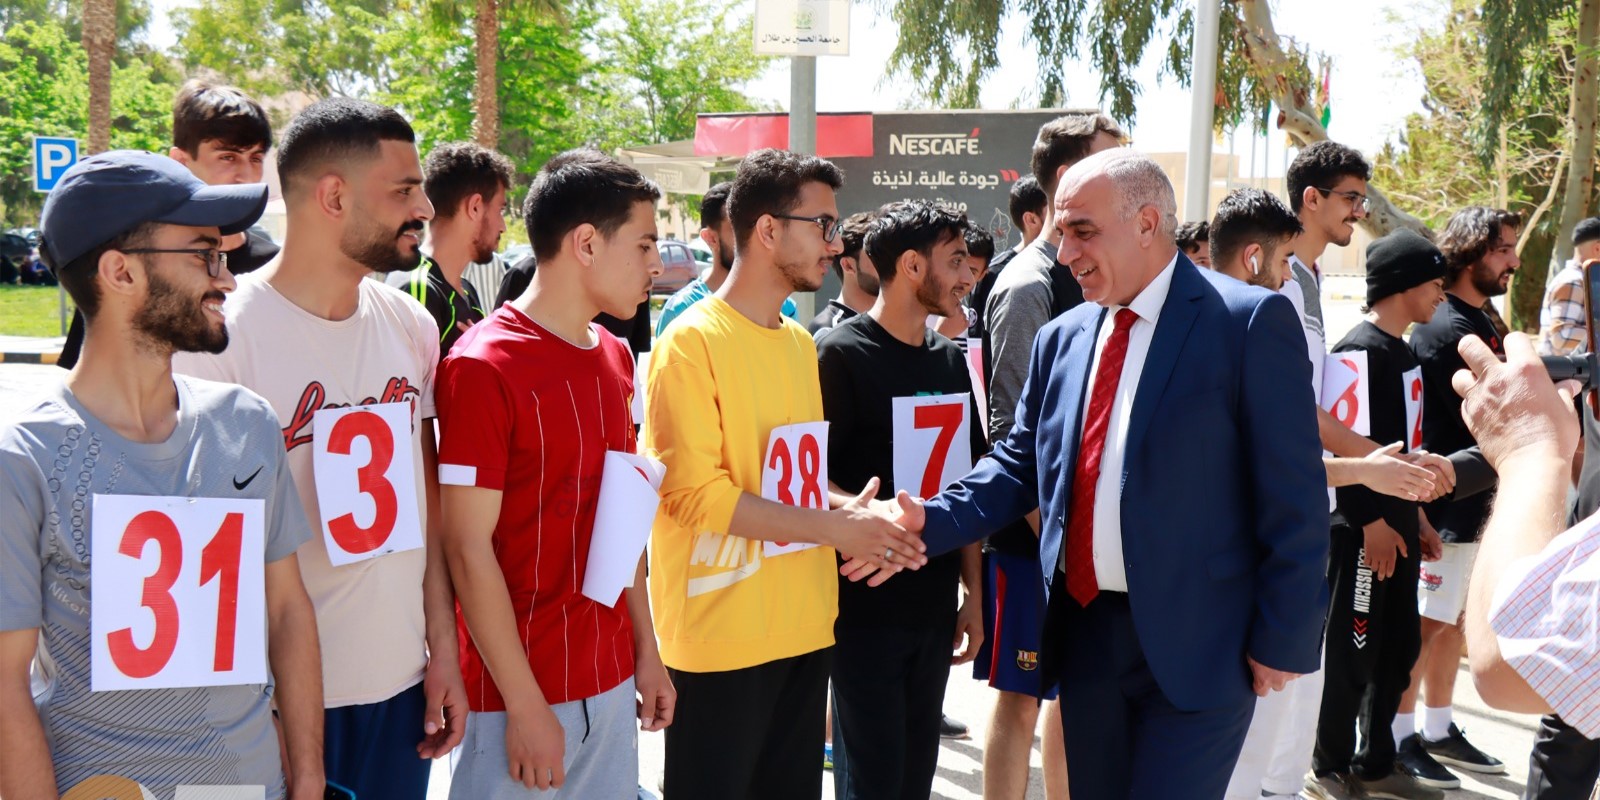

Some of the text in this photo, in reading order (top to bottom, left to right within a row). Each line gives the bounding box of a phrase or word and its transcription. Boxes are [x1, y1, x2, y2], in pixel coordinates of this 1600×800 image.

[761, 34, 780, 43] طلال
[792, 35, 817, 45] الحسين
[819, 34, 840, 44] جامعة
[889, 127, 980, 155] NESCAFÉ
[41, 143, 72, 180] P
[872, 170, 912, 190] لذيذة
[959, 170, 999, 190] جودة
[914, 402, 964, 501] 7
[327, 411, 398, 555] 3
[769, 433, 823, 547] 38
[107, 510, 244, 679] 31
